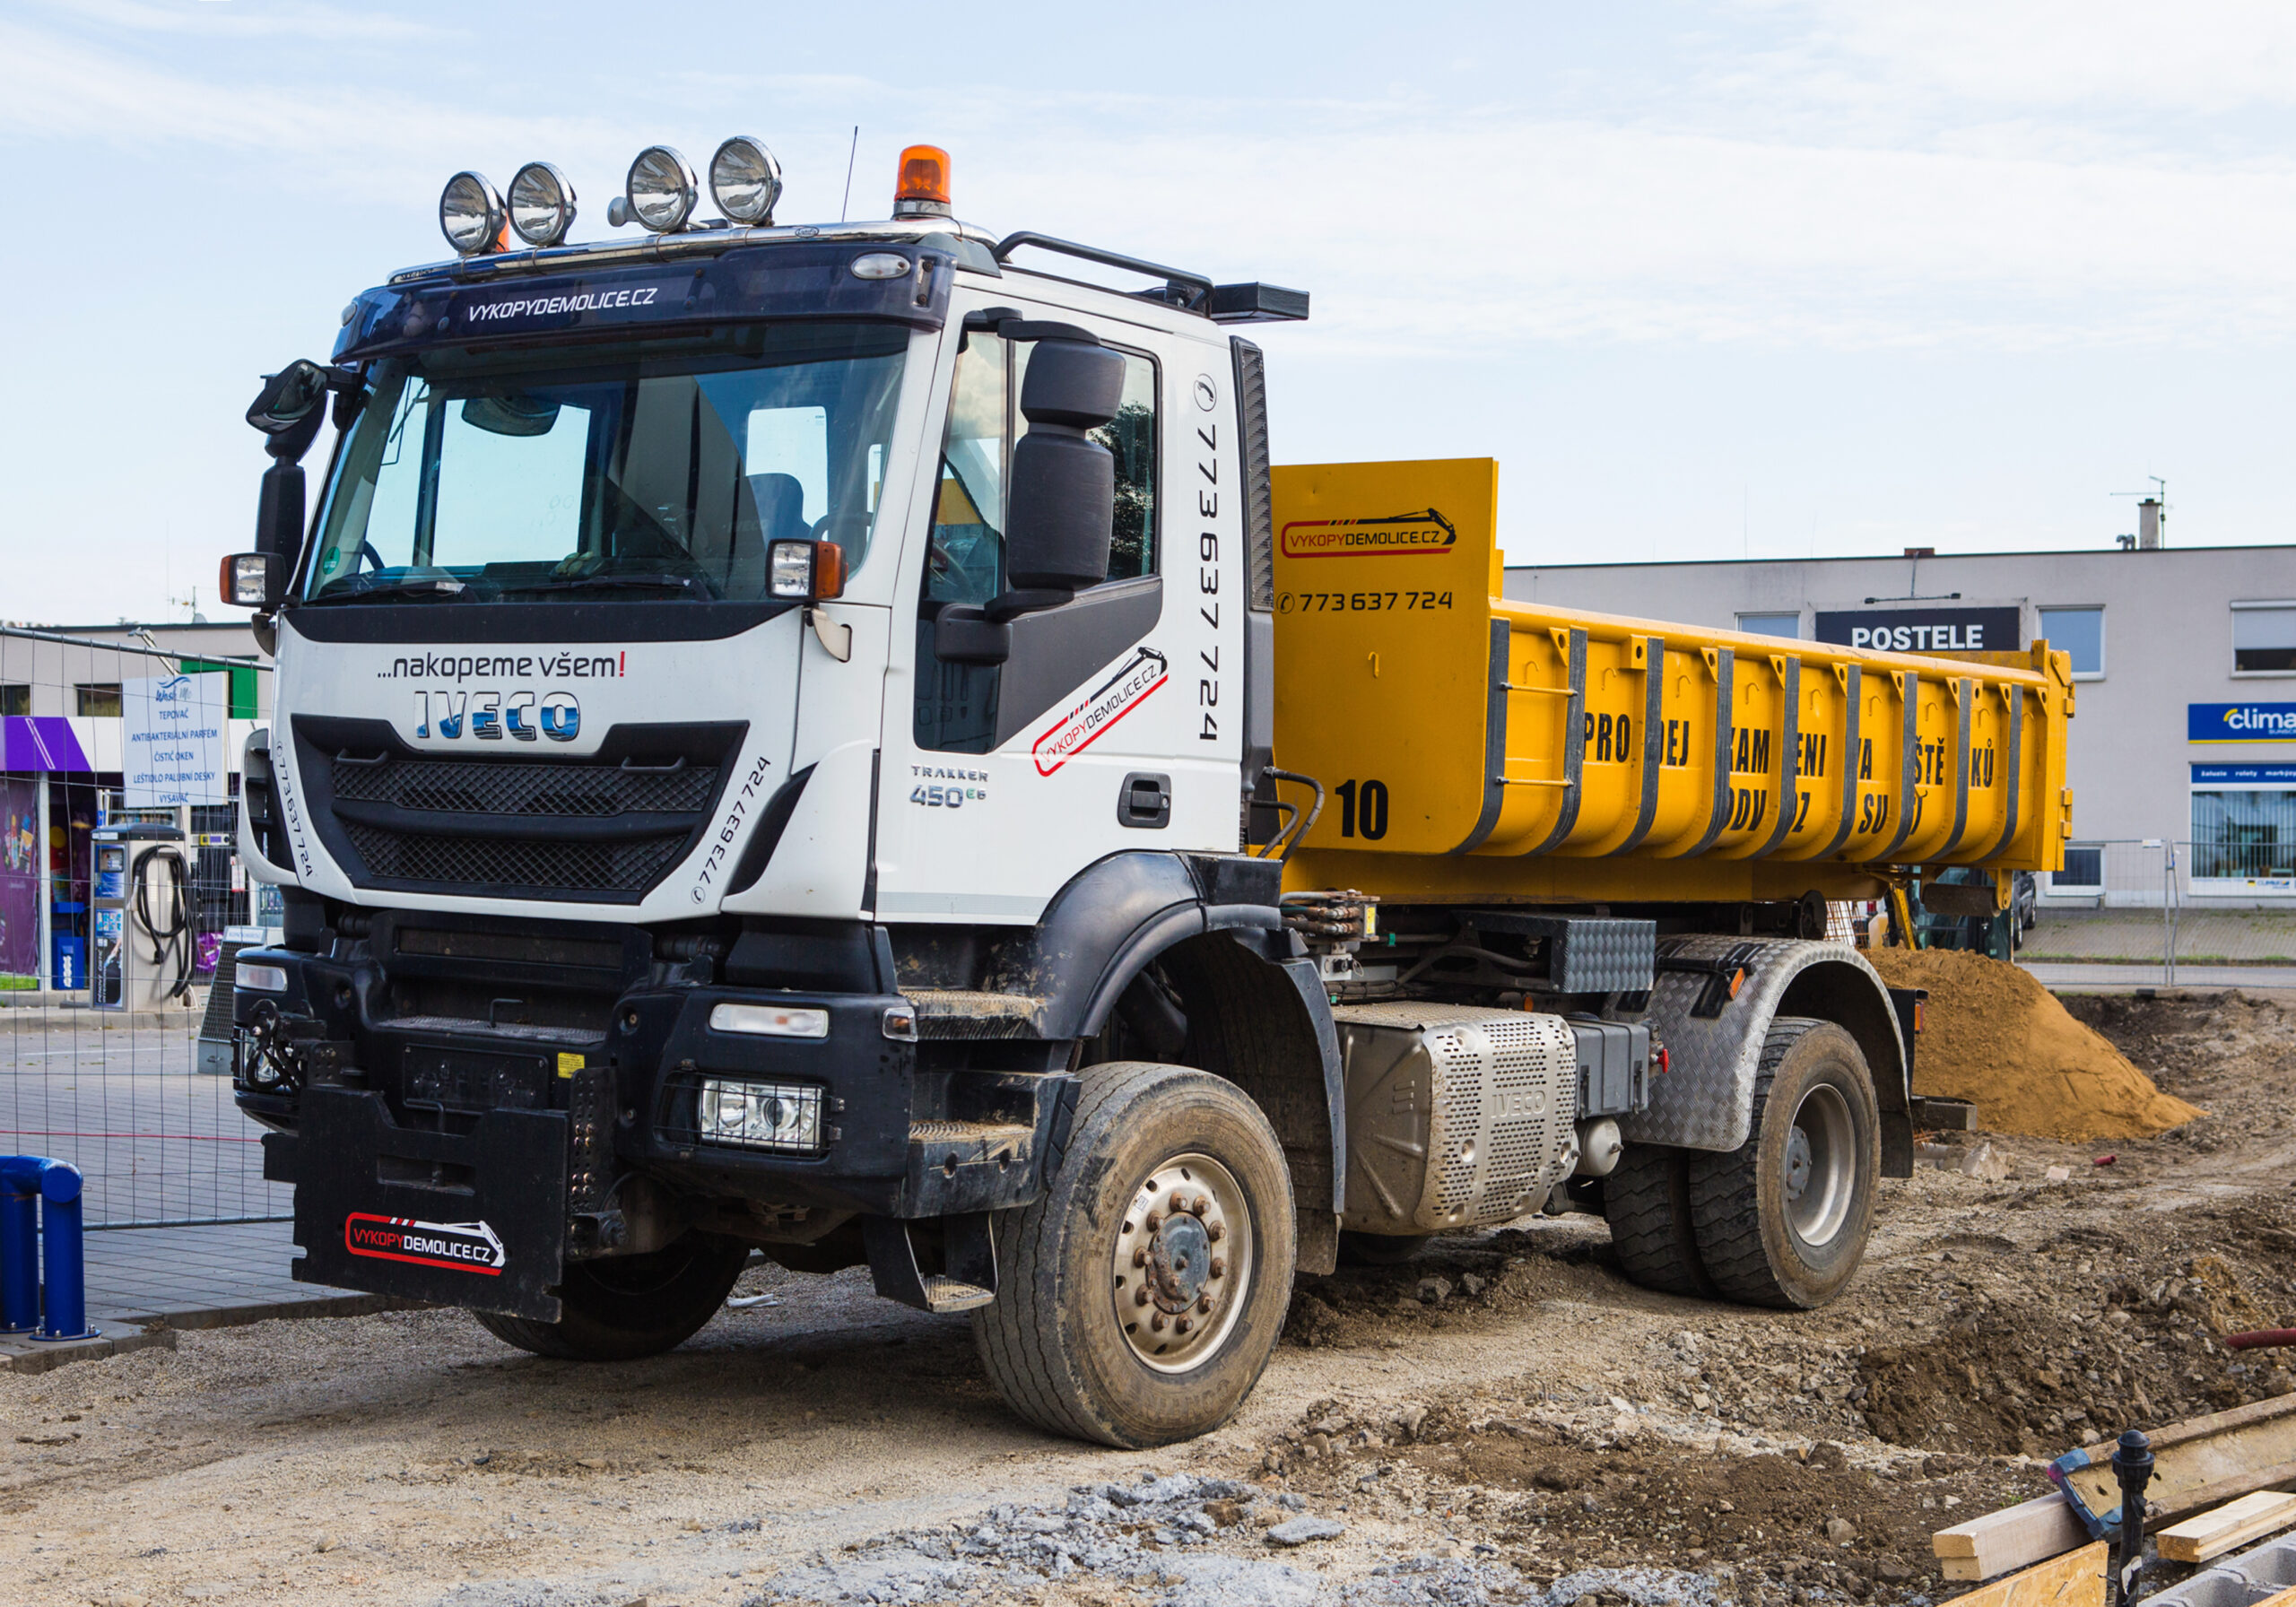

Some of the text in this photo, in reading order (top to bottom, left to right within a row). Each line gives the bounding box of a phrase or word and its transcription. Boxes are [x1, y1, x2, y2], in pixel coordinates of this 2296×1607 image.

[469, 288, 657, 322] VYKOPYDEMOLICE.CZ
[1290, 530, 1440, 548] VYKOPYDEMOLICE.CZ
[1197, 423, 1219, 741] 773 637 724
[1300, 590, 1453, 612] 773 637 724
[1851, 624, 1984, 651] POSTELE
[538, 650, 626, 679] všem!
[413, 691, 582, 742] IVECO
[1040, 664, 1158, 763] VYKOPYDEMOLICE.CZ
[911, 763, 988, 782] TRAKKER
[280, 757, 313, 877] 773 637 724
[699, 756, 771, 884] 773 637 724
[1335, 778, 1389, 841] 10
[1490, 1090, 1546, 1119] IVECO
[353, 1228, 491, 1263] VYKOPYDEMOLICE.CZ
